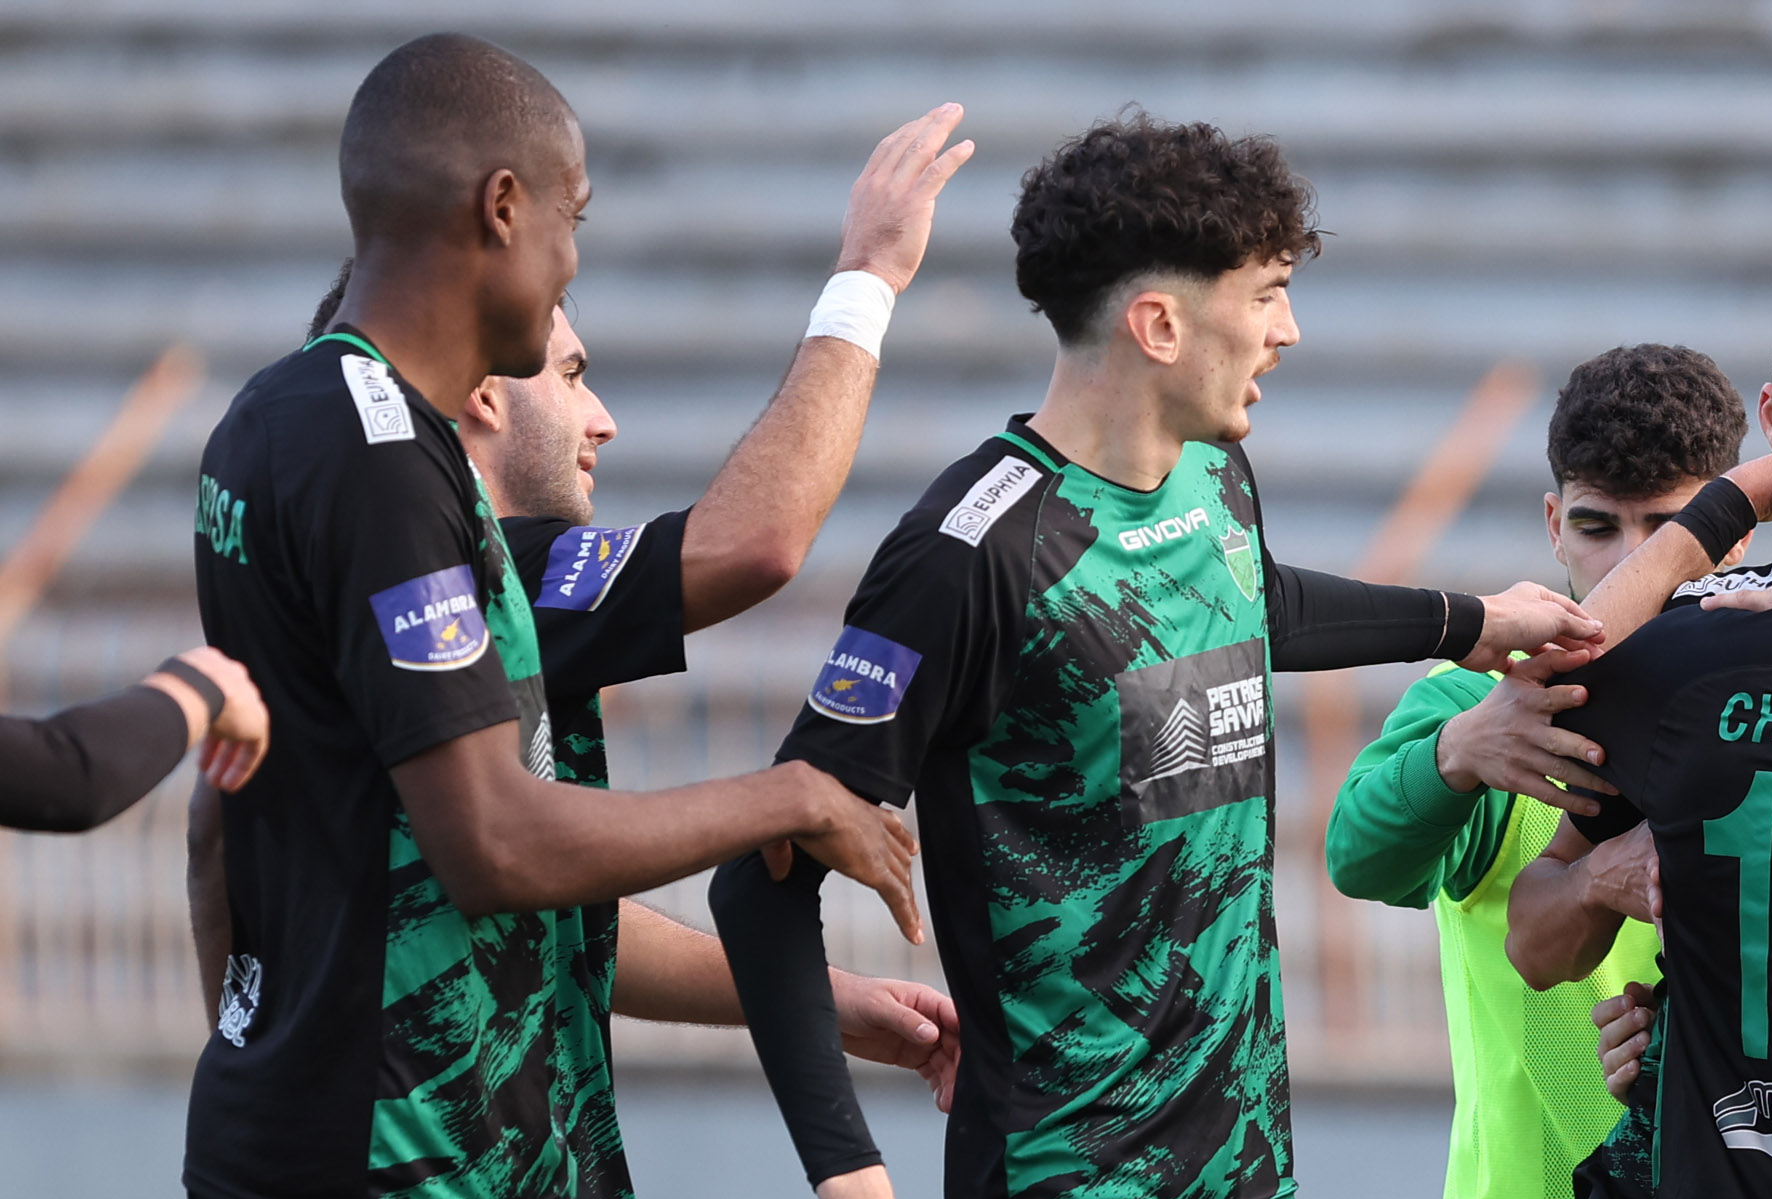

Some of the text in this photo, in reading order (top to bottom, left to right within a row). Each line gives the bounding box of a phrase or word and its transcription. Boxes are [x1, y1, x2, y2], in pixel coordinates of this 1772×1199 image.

[973, 465, 1031, 512] EUPHYIA
[1117, 507, 1210, 551] GIVOVA
[394, 593, 477, 634] ALAMBRA
[827, 650, 897, 689] LAMBRA
[1206, 675, 1263, 711] PETROS
